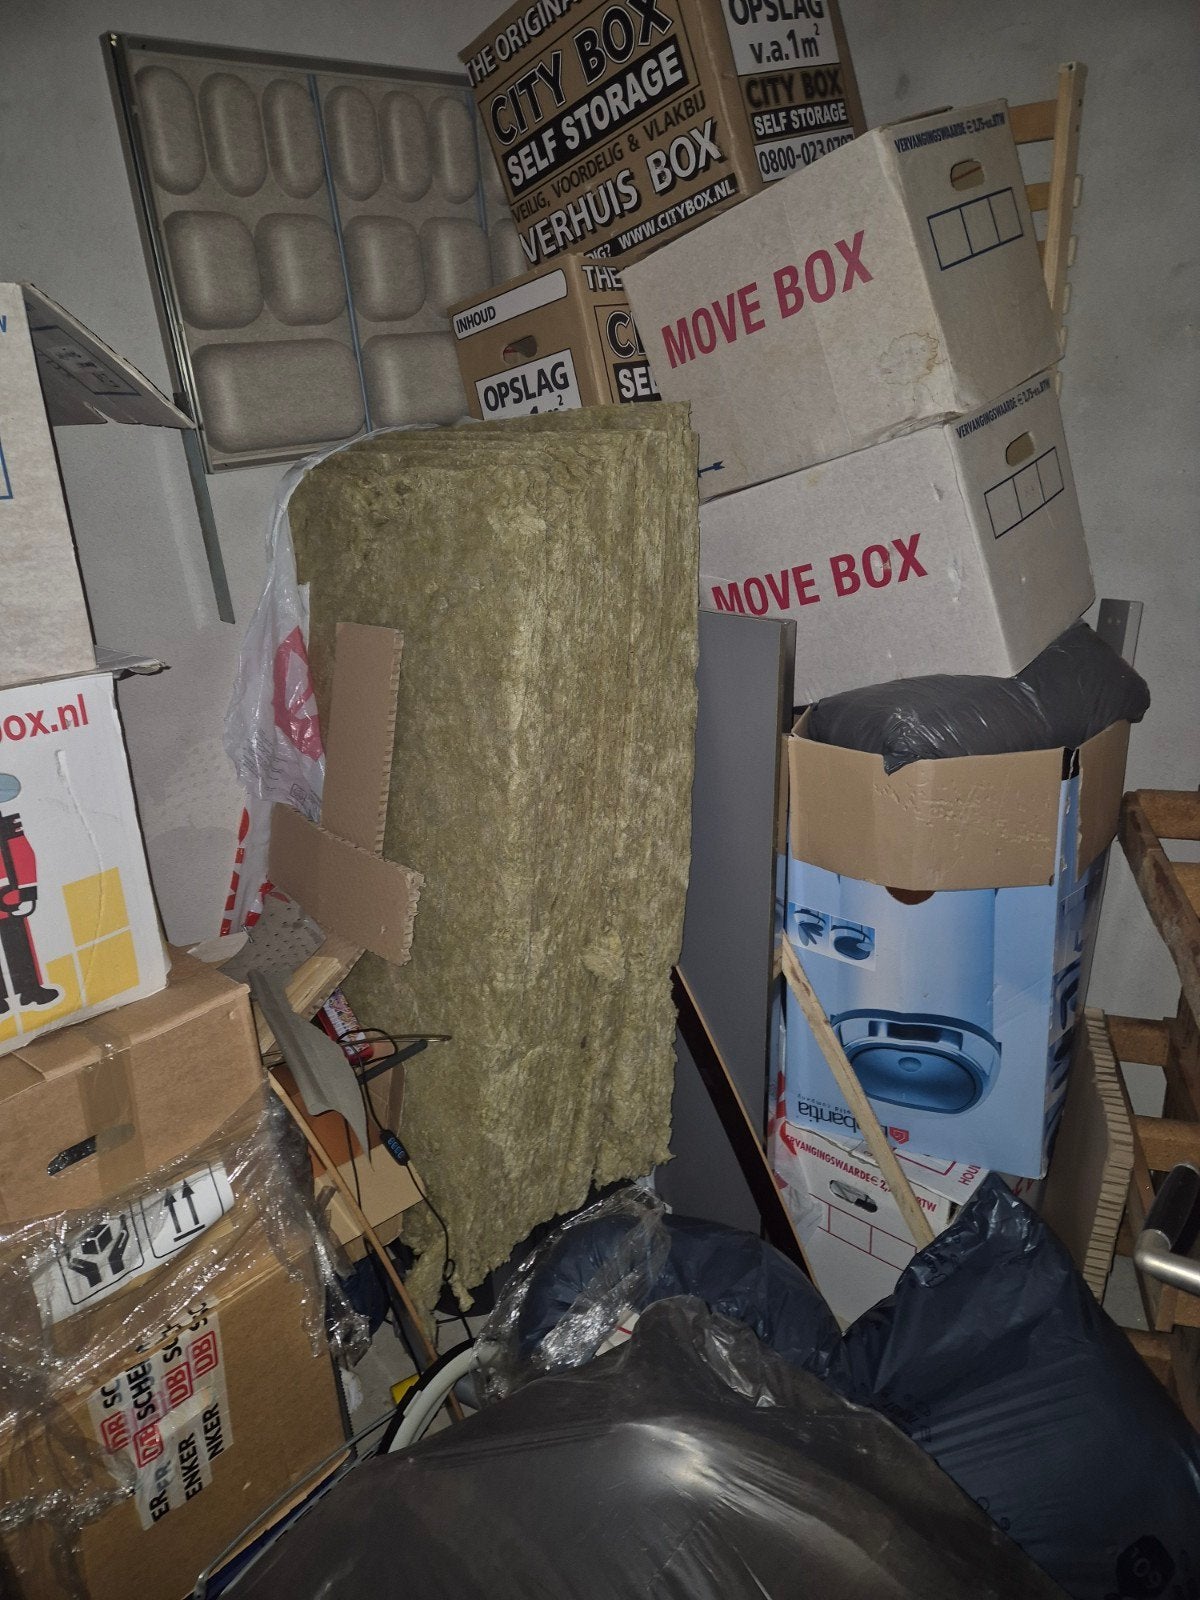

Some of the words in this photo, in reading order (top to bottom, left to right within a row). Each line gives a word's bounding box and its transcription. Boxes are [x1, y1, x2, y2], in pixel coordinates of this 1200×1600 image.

[729, 0, 824, 25] OPSLAG
[464, 46, 498, 87] THE
[491, 50, 566, 146] CITY
[573, 0, 673, 86] BOX
[746, 74, 795, 109] CITY
[802, 68, 843, 99] BOX
[507, 128, 557, 187] SELF
[561, 44, 683, 150] STORAGE
[754, 112, 787, 136] SELF
[790, 103, 847, 130] STORAGE
[511, 191, 551, 223] VEILIG,
[551, 141, 624, 198] VOORDELIG
[628, 133, 641, 152] &
[643, 91, 706, 141] VLAKBIJ
[518, 167, 640, 265] VERHUIS
[646, 119, 722, 193] BOX
[618, 179, 735, 250] WWW.CITYBOX.NL
[582, 265, 623, 289] THE
[661, 282, 766, 369] MOVE
[773, 229, 874, 319] BOX
[456, 305, 497, 334] INHOUD
[483, 361, 570, 412] OPSLAG
[711, 563, 821, 616] MOVE
[830, 533, 929, 598] BOX
[0, 693, 89, 743] ox.nl
[126, 1360, 154, 1421] SCHE
[165, 1367, 189, 1405] DB
[178, 1432, 203, 1501] ENKER
